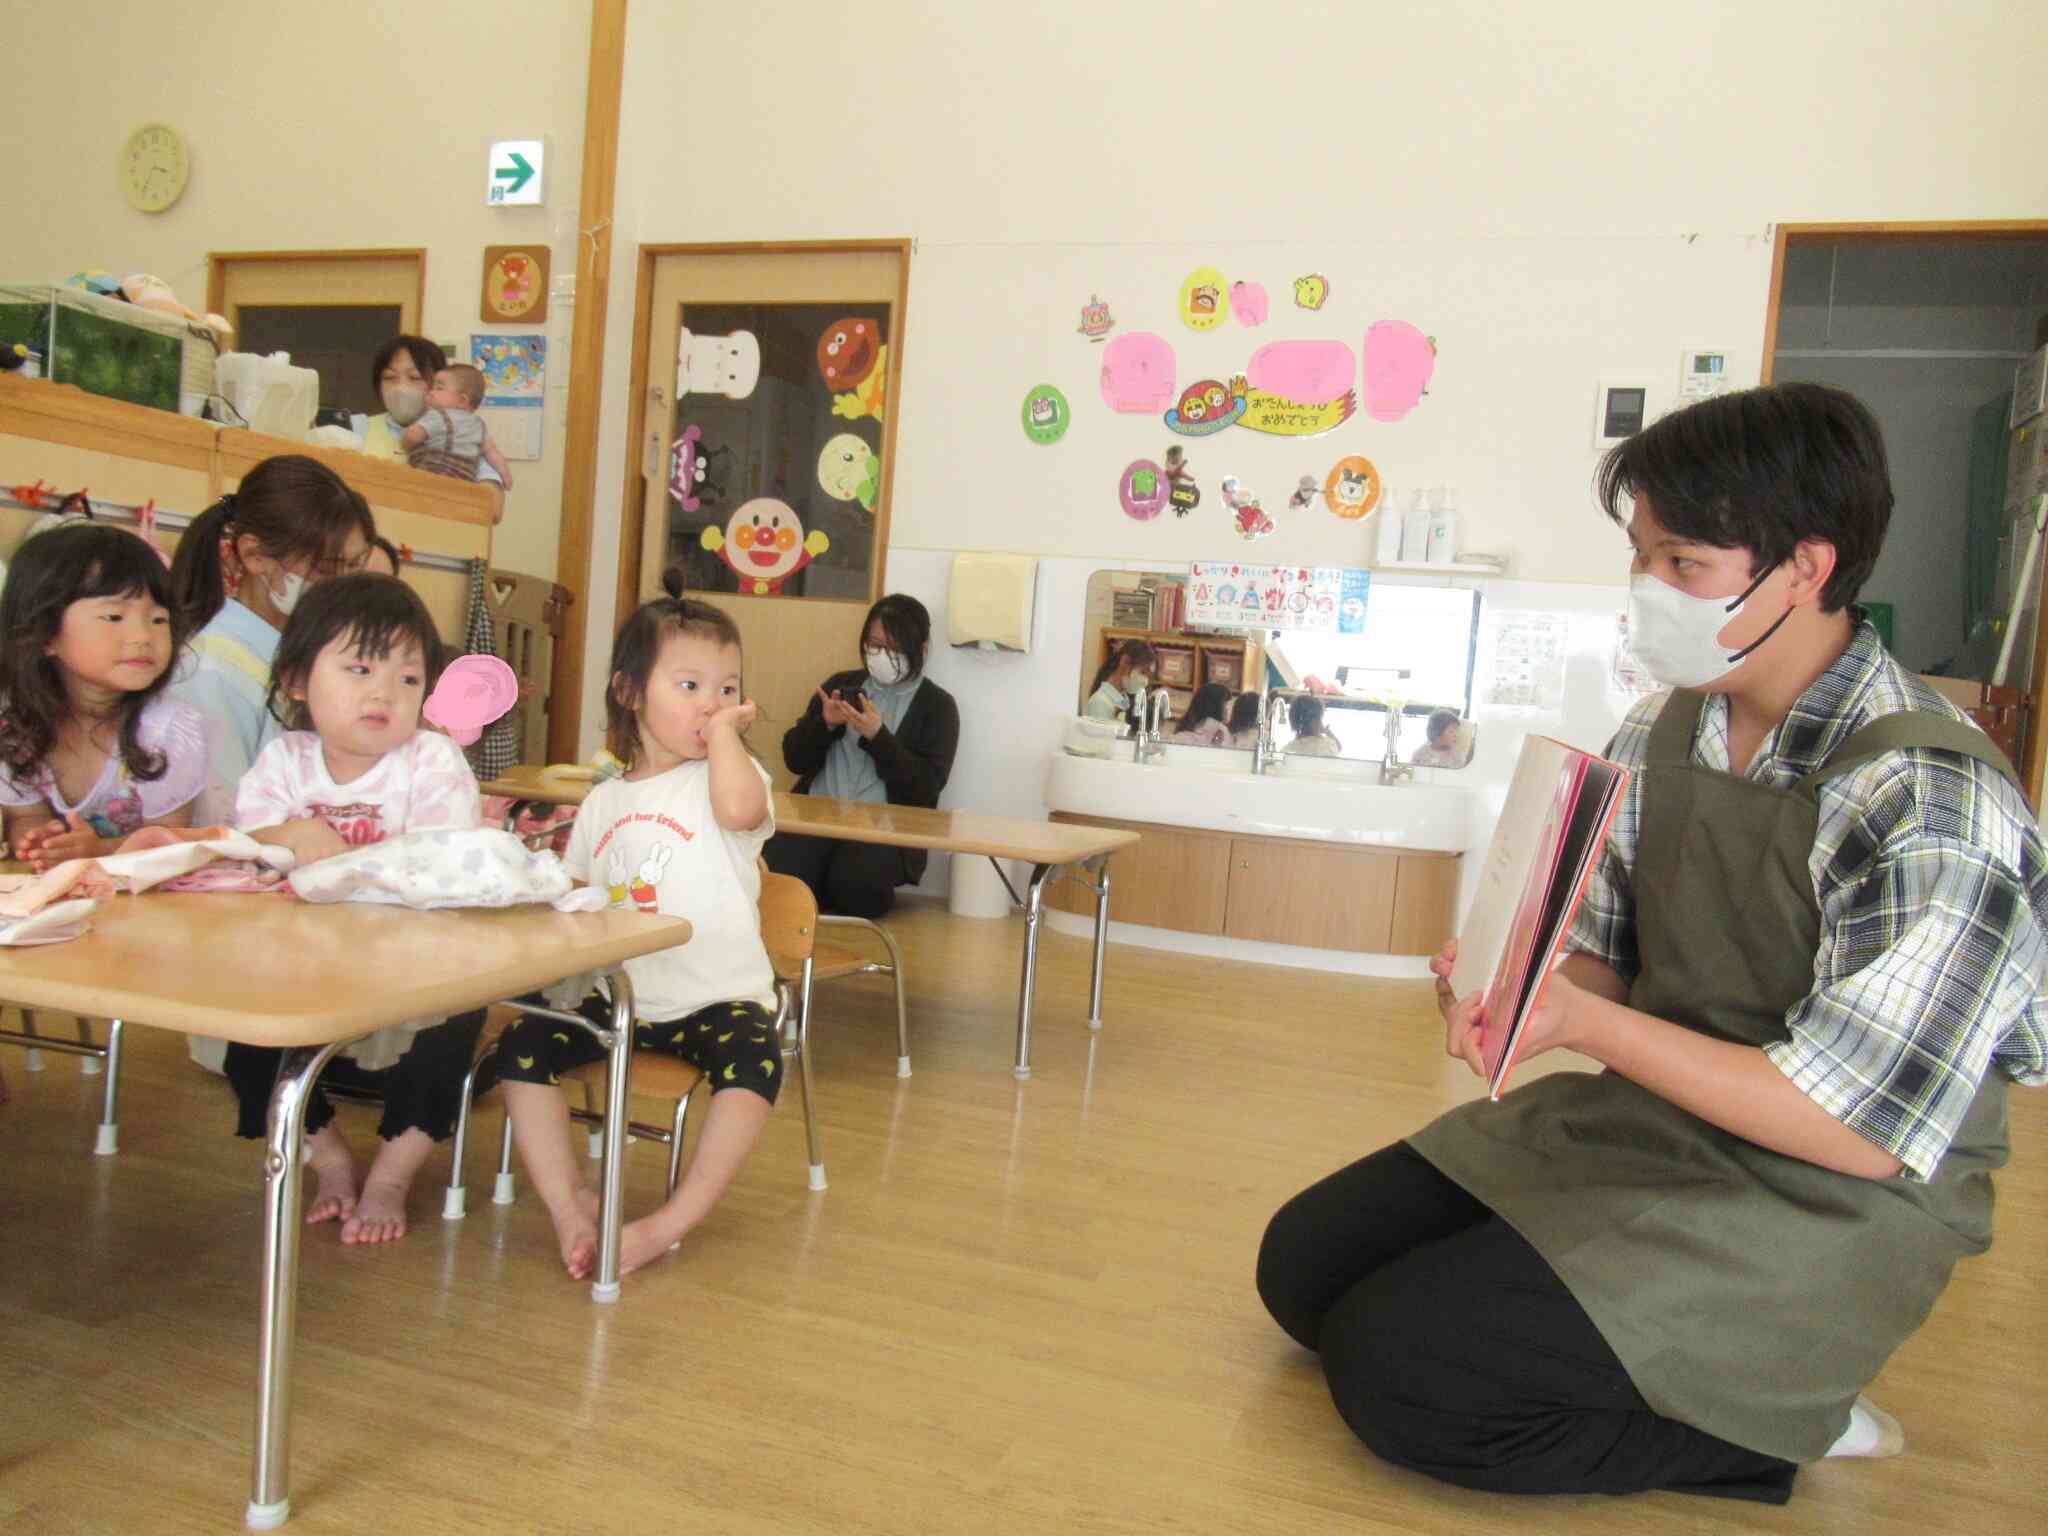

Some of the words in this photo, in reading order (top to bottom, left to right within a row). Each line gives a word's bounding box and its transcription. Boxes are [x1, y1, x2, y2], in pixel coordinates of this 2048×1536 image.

[1262, 413, 1320, 426] おめでとう
[614, 813, 632, 829] and
[635, 812, 656, 821] her
[657, 812, 695, 841] friend
